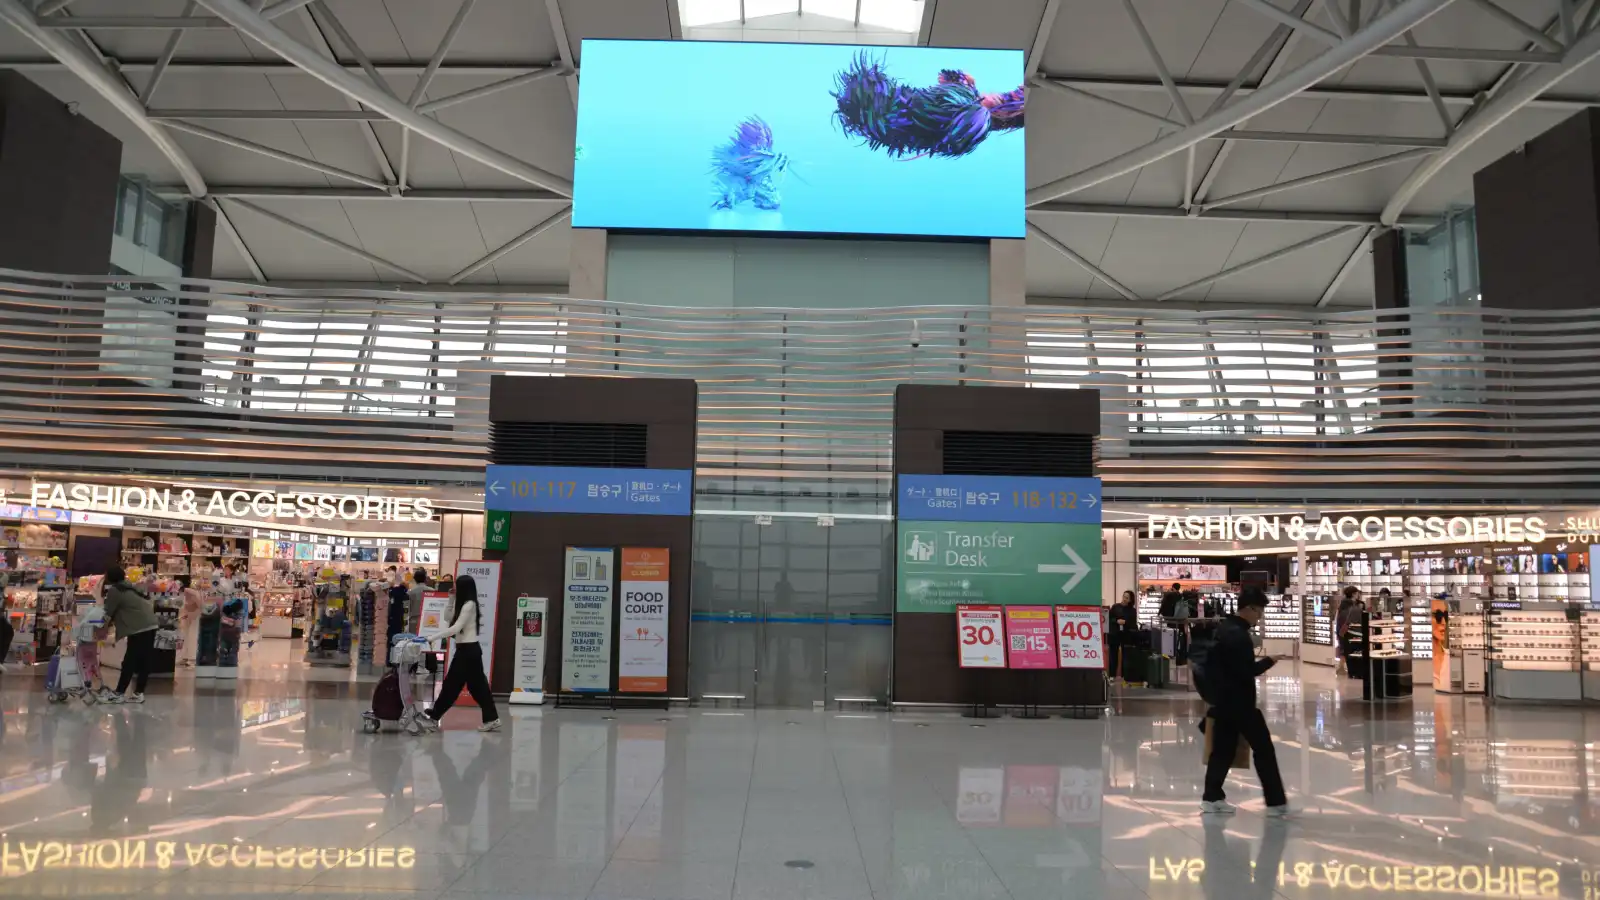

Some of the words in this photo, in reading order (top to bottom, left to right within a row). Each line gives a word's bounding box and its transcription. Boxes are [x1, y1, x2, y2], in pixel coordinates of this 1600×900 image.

[511, 481, 576, 498] 101-117
[587, 483, 622, 498] 탑승구
[31, 483, 171, 514] FASHION
[177, 489, 199, 515] &
[205, 490, 433, 522] ACCESSORIES
[631, 493, 661, 502] Gates
[927, 498, 957, 508] Gates
[966, 491, 1000, 505] 탑승구
[1012, 491, 1078, 508] 118-132
[1148, 514, 1280, 541] FASHION
[1287, 516, 1309, 541] &
[1315, 515, 1546, 542] ACCESSORIES
[491, 534, 503, 542] AED
[945, 530, 1015, 548] Transfer
[945, 550, 989, 567] Desk
[466, 567, 491, 575] 전자제품
[626, 591, 663, 602] FOOD
[625, 604, 664, 614] COURT
